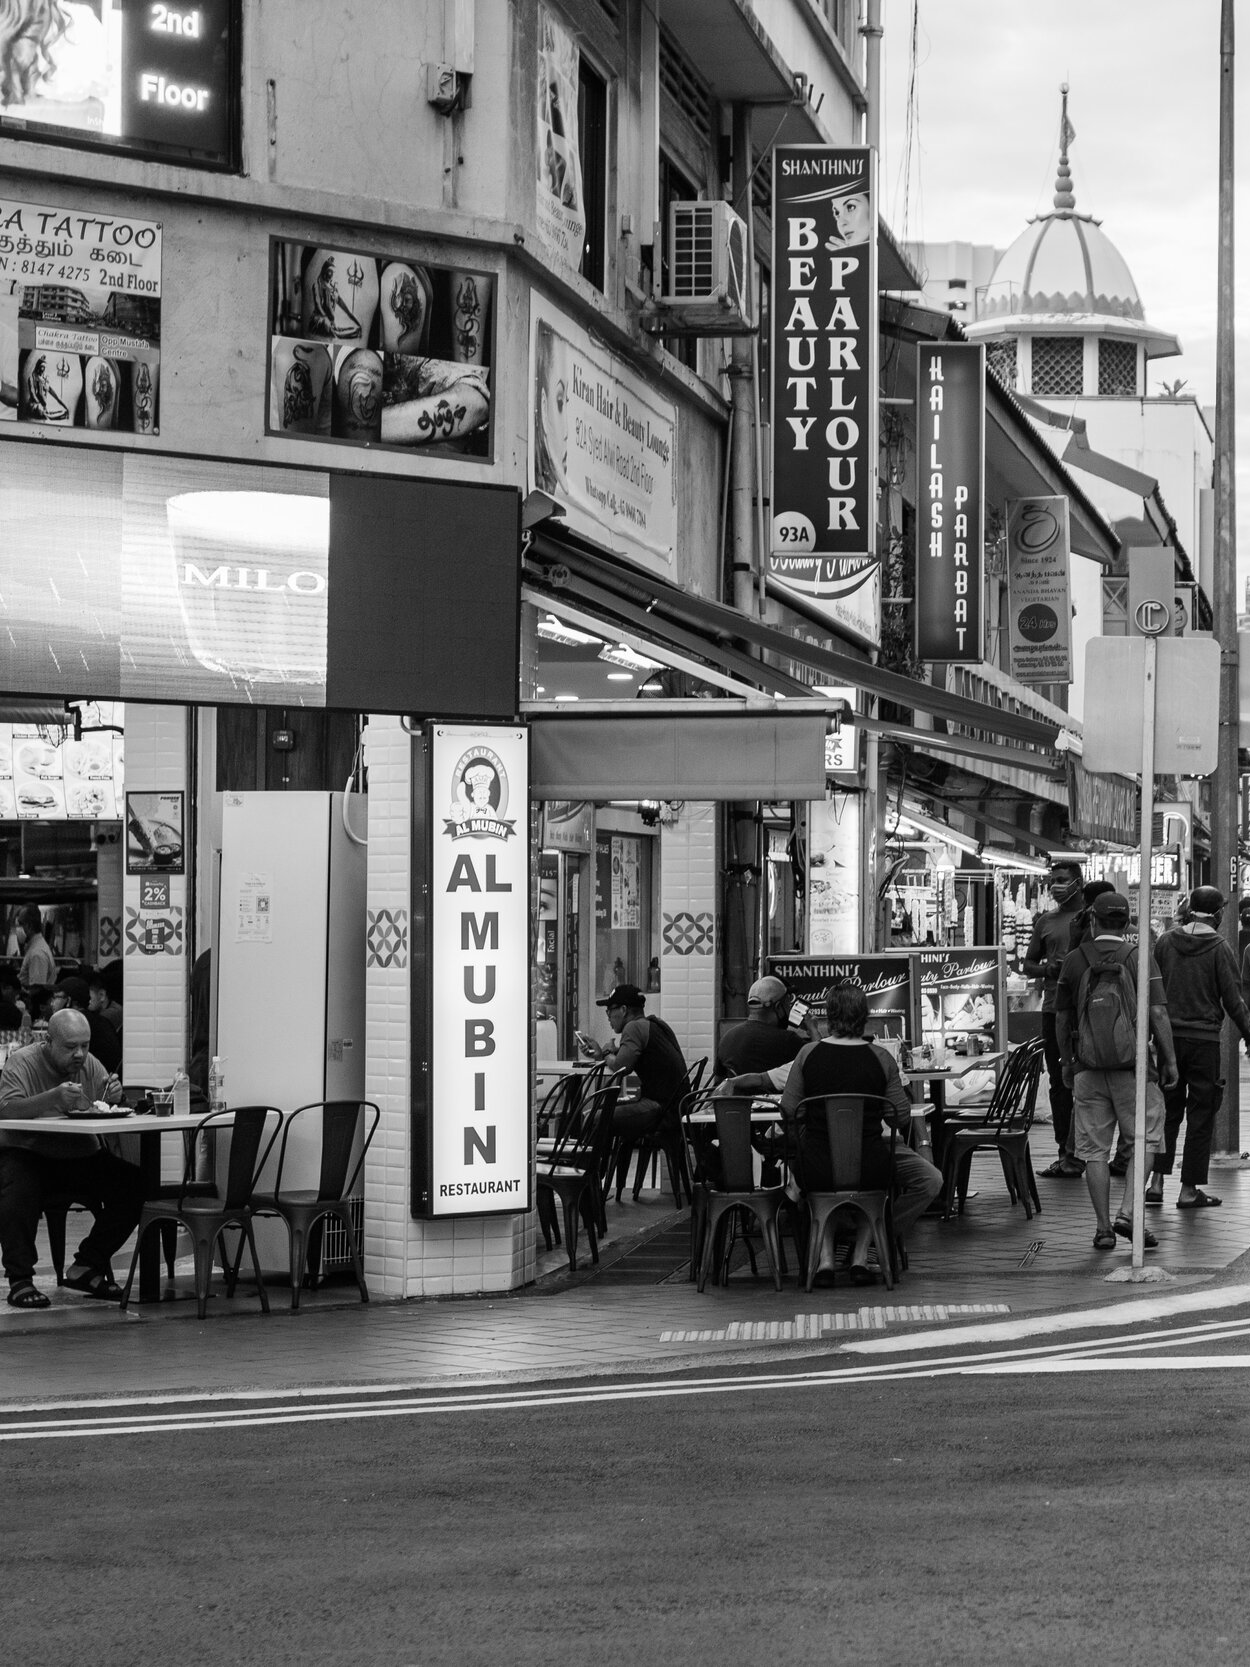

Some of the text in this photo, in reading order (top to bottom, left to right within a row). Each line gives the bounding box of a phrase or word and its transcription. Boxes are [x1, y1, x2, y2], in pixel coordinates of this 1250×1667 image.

[151, 4, 199, 38] 2nd
[141, 73, 209, 110] Floor
[782, 159, 864, 176] SHANTHINI'S
[0, 207, 156, 248] A TATTOO
[21, 259, 54, 276] 8147
[58, 265, 90, 281] 4275
[100, 269, 123, 288] 2nd
[127, 274, 158, 292] Floor
[38, 329, 98, 342] Chakra Tattoo
[102, 336, 149, 349] Opp Mustafa
[784, 217, 819, 450] BEAUTY
[102, 348, 127, 358] Centre
[825, 257, 860, 530] PARLOUR
[573, 364, 595, 407] Kiran
[597, 383, 613, 421] Hair
[622, 402, 645, 452] Beauty
[647, 421, 670, 468] Lounge
[779, 526, 809, 542] 93A
[180, 562, 327, 594] MILO
[954, 486, 969, 651] PARBAT
[1020, 616, 1037, 629] 24
[455, 747, 507, 778] RESTAURANT
[456, 820, 508, 837] AL MUBIN
[446, 854, 512, 893] AL
[144, 887, 166, 901] 2%
[775, 964, 860, 977] SHANTHINI'S
[921, 953, 950, 963] HINI'S
[942, 958, 996, 978] Parlour
[460, 911, 499, 1165] MUBIN
[439, 1179, 521, 1198] RESTAURANT
